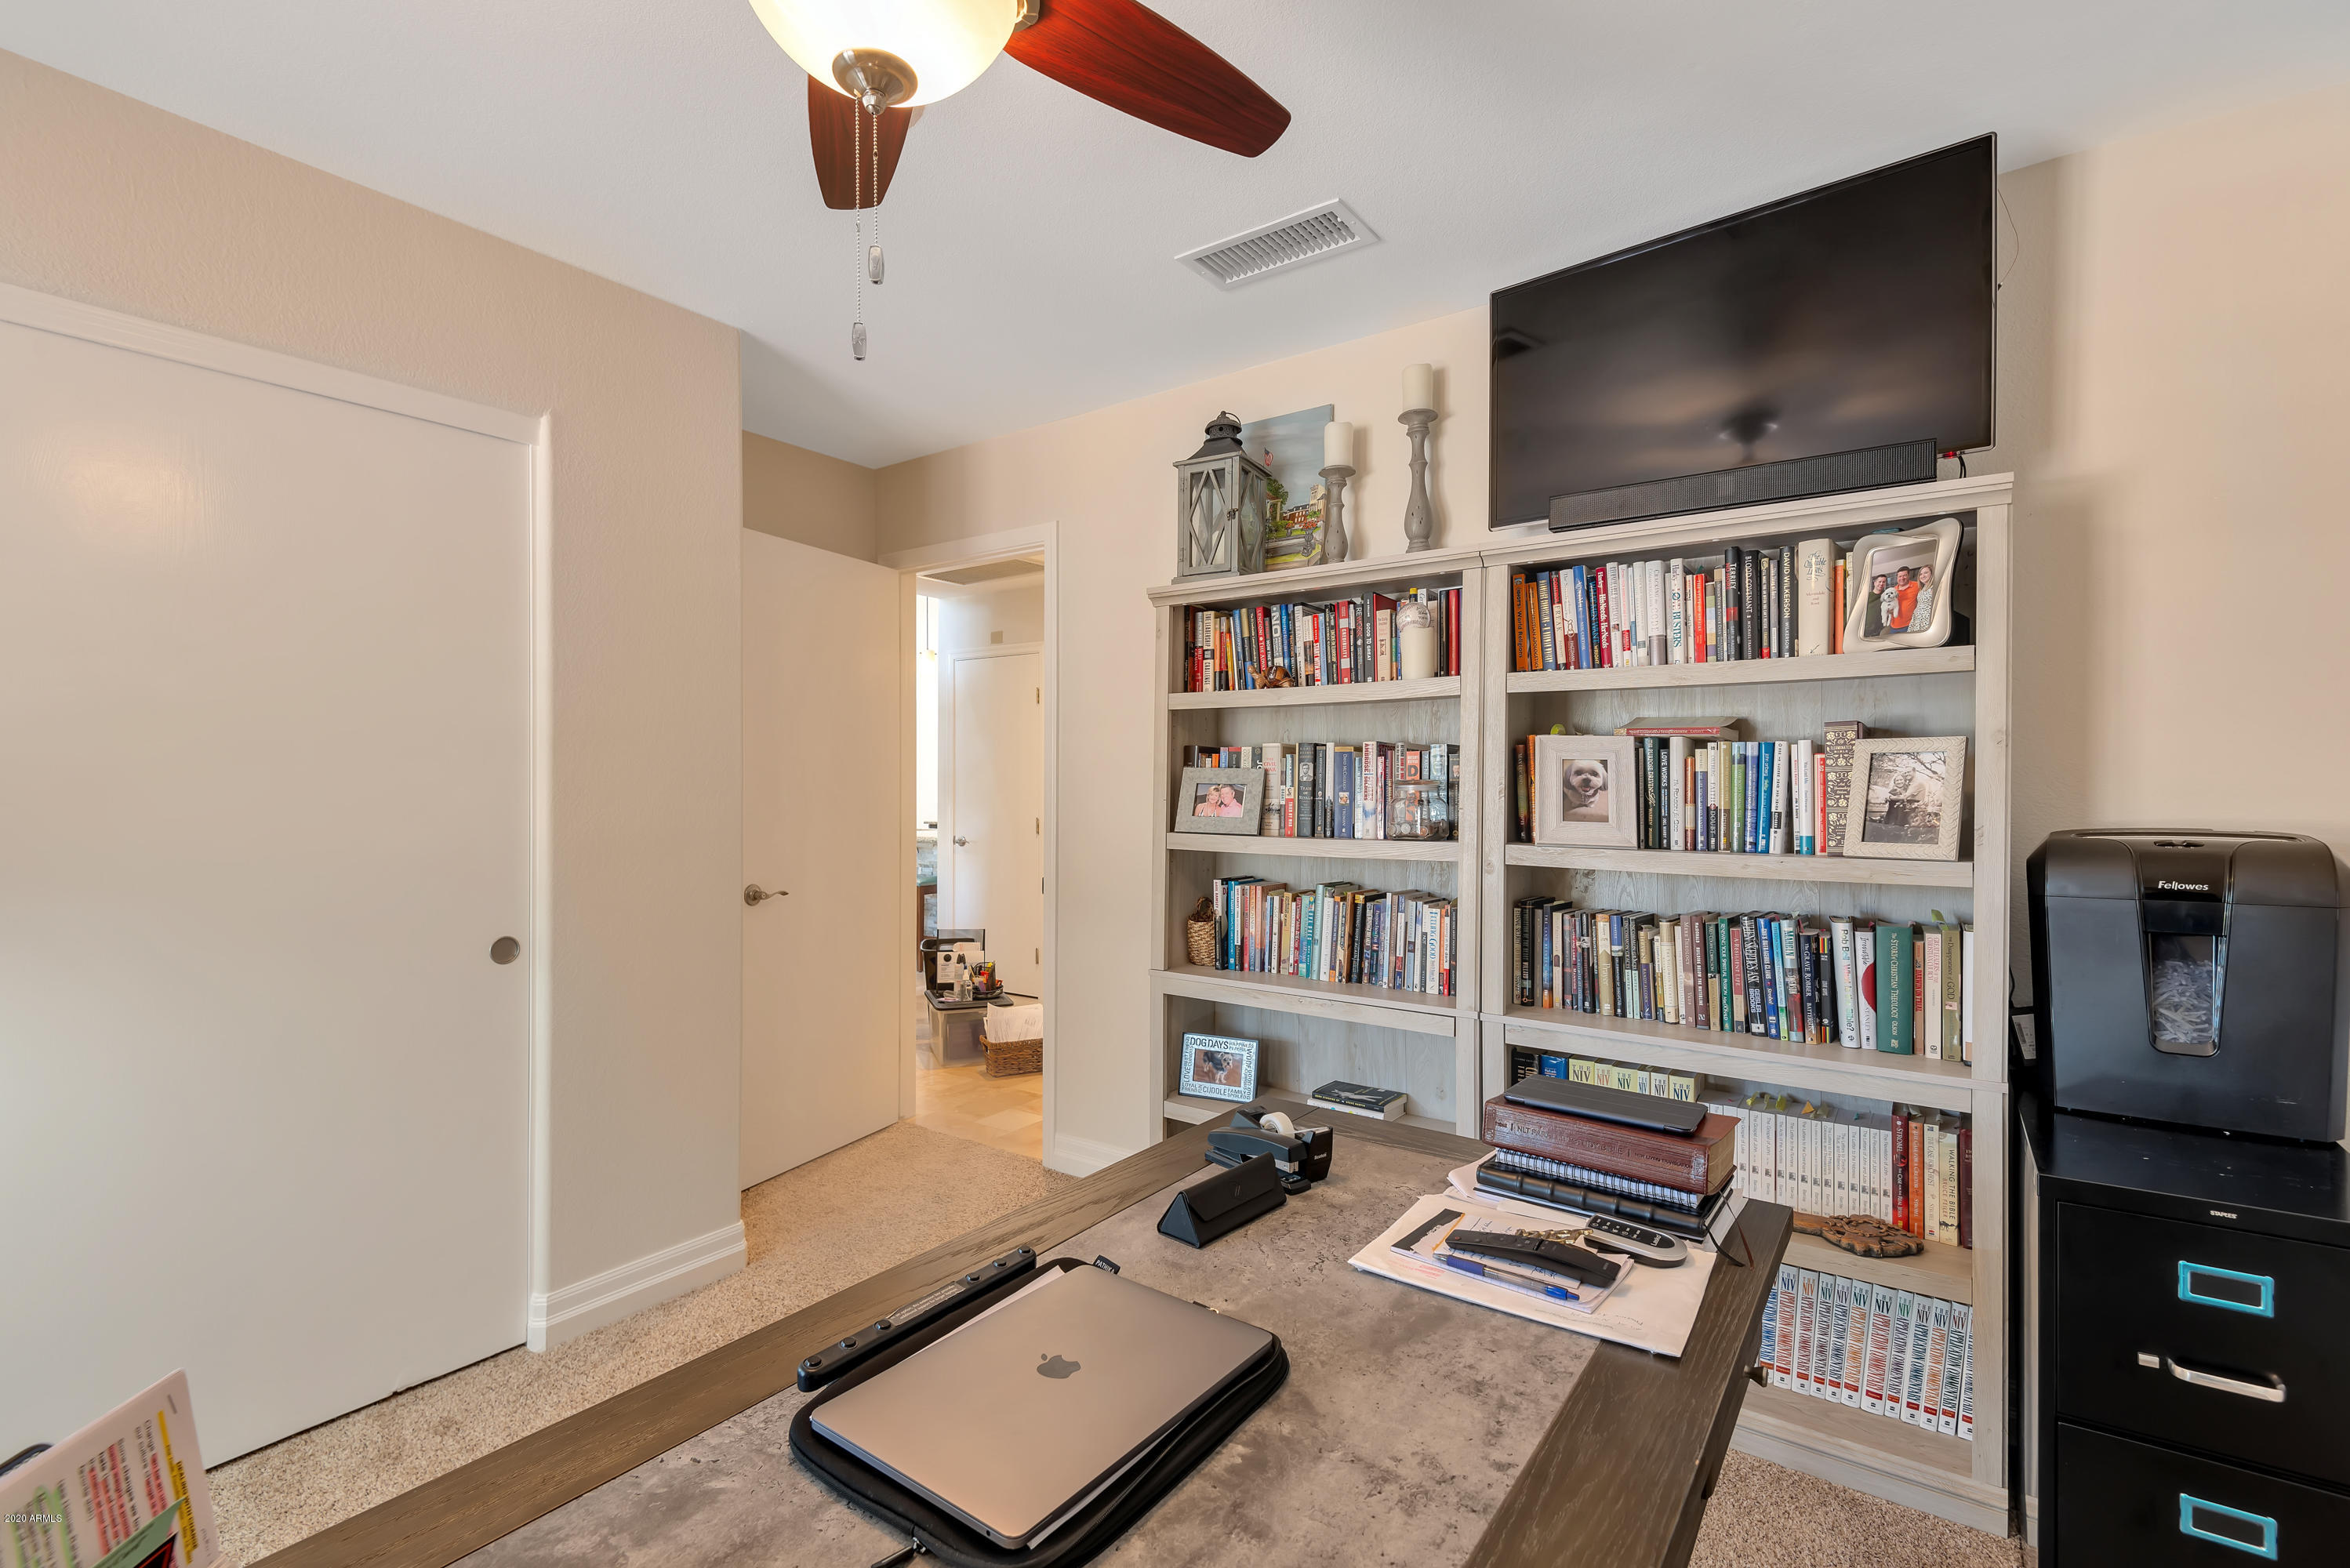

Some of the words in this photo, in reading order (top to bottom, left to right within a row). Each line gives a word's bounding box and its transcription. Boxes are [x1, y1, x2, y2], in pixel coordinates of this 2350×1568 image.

[1725, 563, 1731, 573] NO
[1272, 612, 1280, 637] NO
[1672, 612, 1681, 648] BUSTERS
[2158, 880, 2209, 891] Fellowes
[1429, 912, 1438, 937] FEELING
[1743, 920, 1755, 940] WHEN
[1429, 938, 1437, 960] GOOD
[1784, 930, 1794, 956] MARGIN
[1891, 939, 1899, 956] STORY
[1747, 971, 1760, 983] ASK
[1891, 989, 1899, 1018] THEOLOGY
[1190, 1037, 1207, 1047] DOG
[1208, 1039, 1229, 1050] DAYS
[1573, 1069, 1590, 1082] NIV
[1596, 1074, 1610, 1087] NIV
[1203, 1086, 1227, 1096] CUDDLE
[1617, 1077, 1631, 1091] NIV
[1638, 1081, 1647, 1094] NIV
[1654, 1083, 1666, 1097] NIV
[1673, 1087, 1691, 1102] NIV
[1095, 1260, 1114, 1273] PATHIKA
[1781, 1277, 1796, 1291] NIV
[1803, 1281, 1814, 1296] NIV
[1821, 1287, 1832, 1301] NIV
[1836, 1289, 1849, 1304] NIV
[1853, 1291, 1869, 1307] NIV
[1876, 1293, 1893, 1301] THE
[1874, 1298, 1892, 1315] NIV
[1898, 1303, 1911, 1317] NIV
[1916, 1309, 1930, 1324] NIV
[1934, 1312, 1948, 1328] NIV
[1952, 1316, 1967, 1330] NIV
